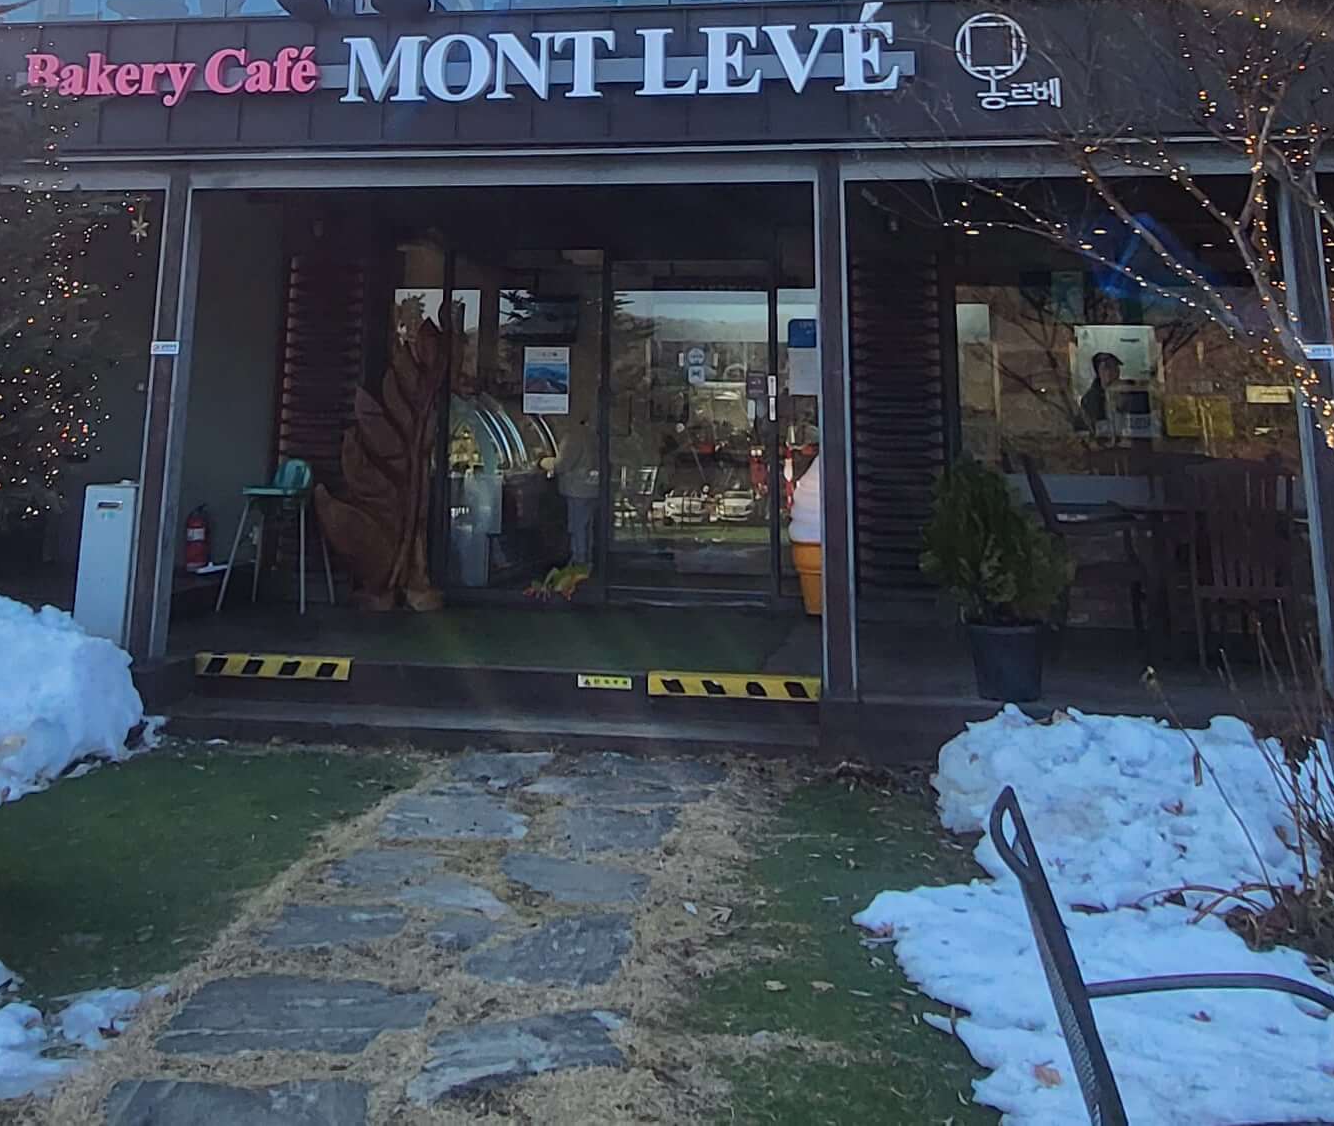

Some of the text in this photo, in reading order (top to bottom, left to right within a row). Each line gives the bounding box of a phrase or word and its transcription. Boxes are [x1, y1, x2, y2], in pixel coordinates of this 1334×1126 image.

[25, 46, 317, 107] Bakery Café
[339, 2, 900, 103] MONT LEVÉ
